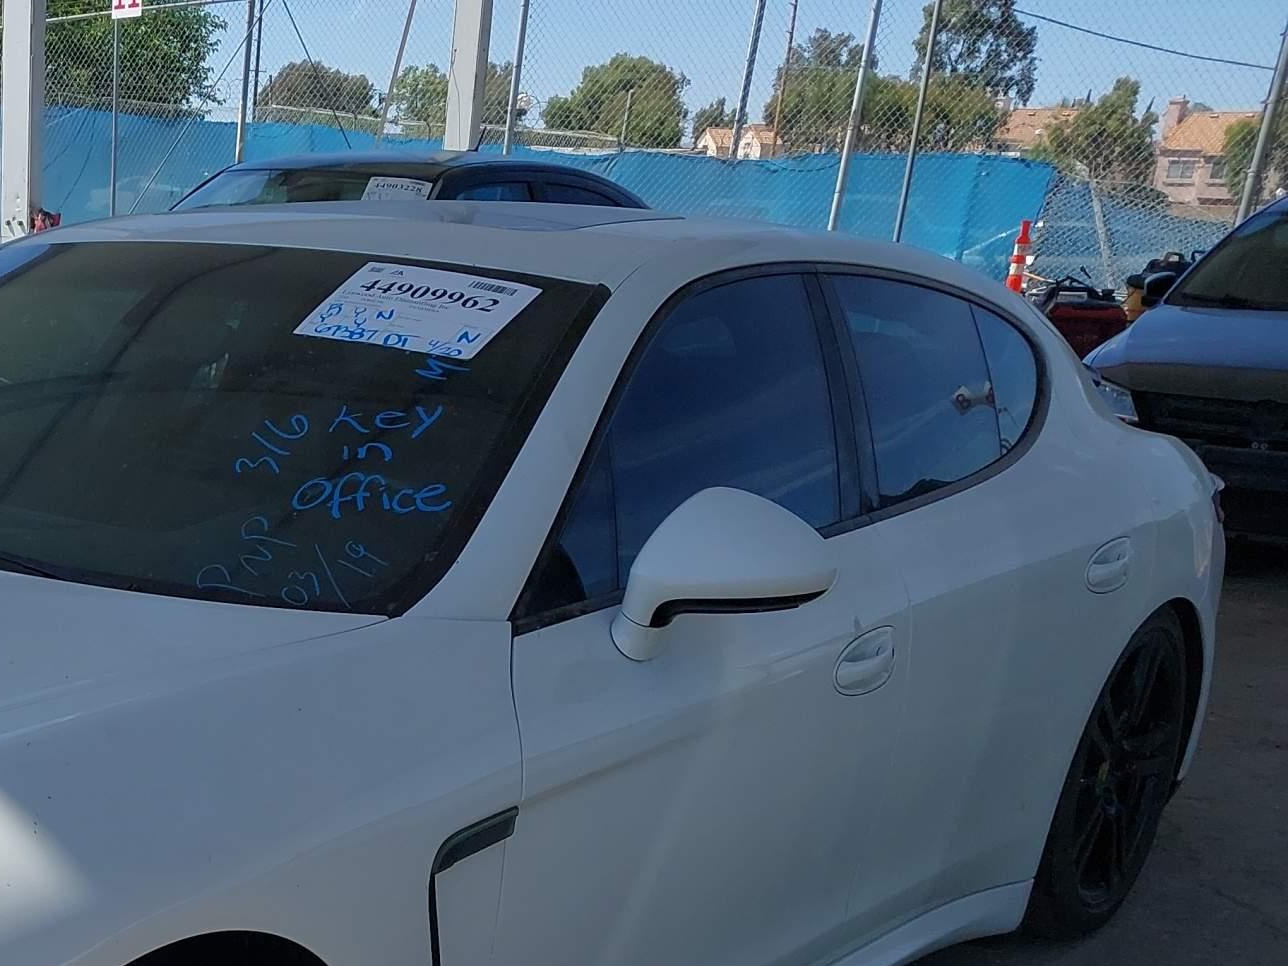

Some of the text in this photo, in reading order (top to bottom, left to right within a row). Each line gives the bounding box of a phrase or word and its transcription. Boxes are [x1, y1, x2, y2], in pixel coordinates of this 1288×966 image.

[360, 279, 501, 313] 44909962
[375, 309, 394, 320] N
[457, 329, 481, 345] N
[342, 442, 393, 461] in
[290, 472, 452, 519] Office
